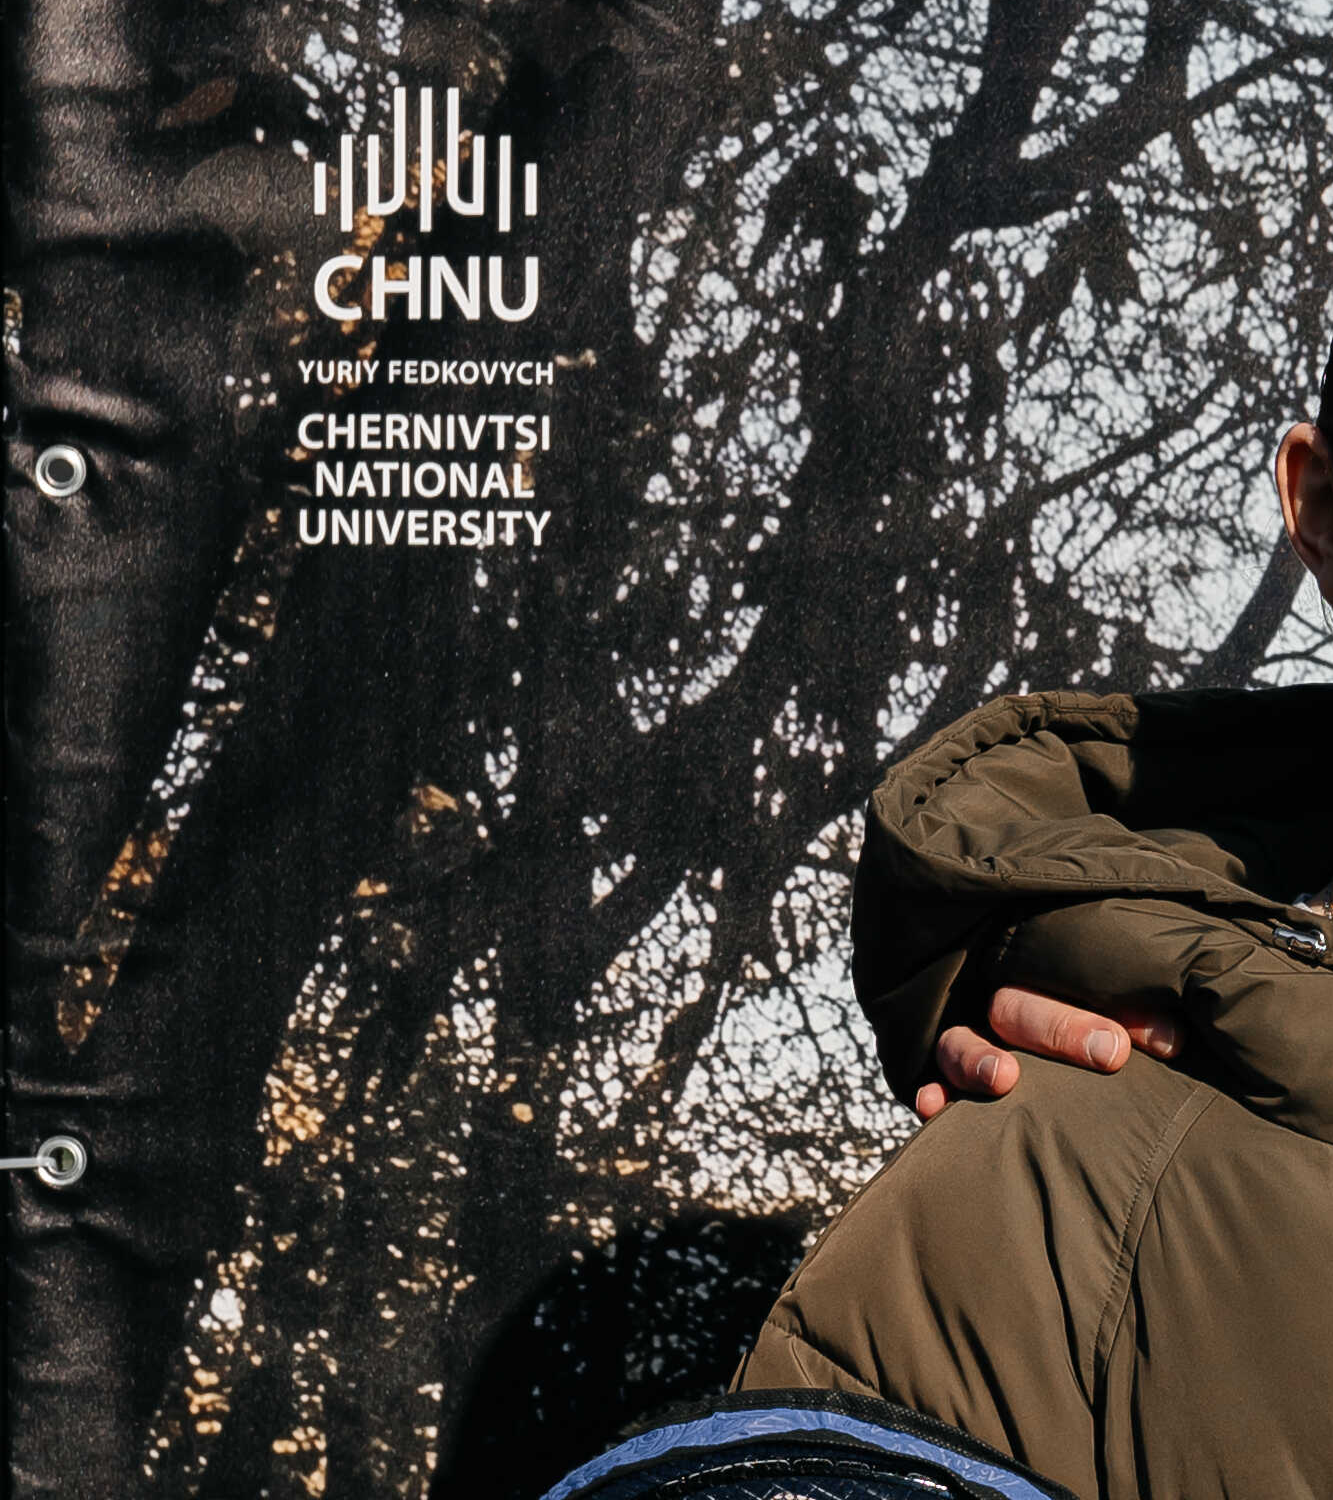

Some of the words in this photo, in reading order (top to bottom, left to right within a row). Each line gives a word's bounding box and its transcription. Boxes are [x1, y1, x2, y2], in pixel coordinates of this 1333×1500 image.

[313, 254, 539, 323] CHNU
[298, 359, 380, 385] YURIY
[387, 360, 555, 386] FEDKOVYCH
[297, 412, 551, 452] CHERNIVTSI
[314, 460, 536, 499] NATIONAL
[298, 509, 552, 547] UNIVERSITY
